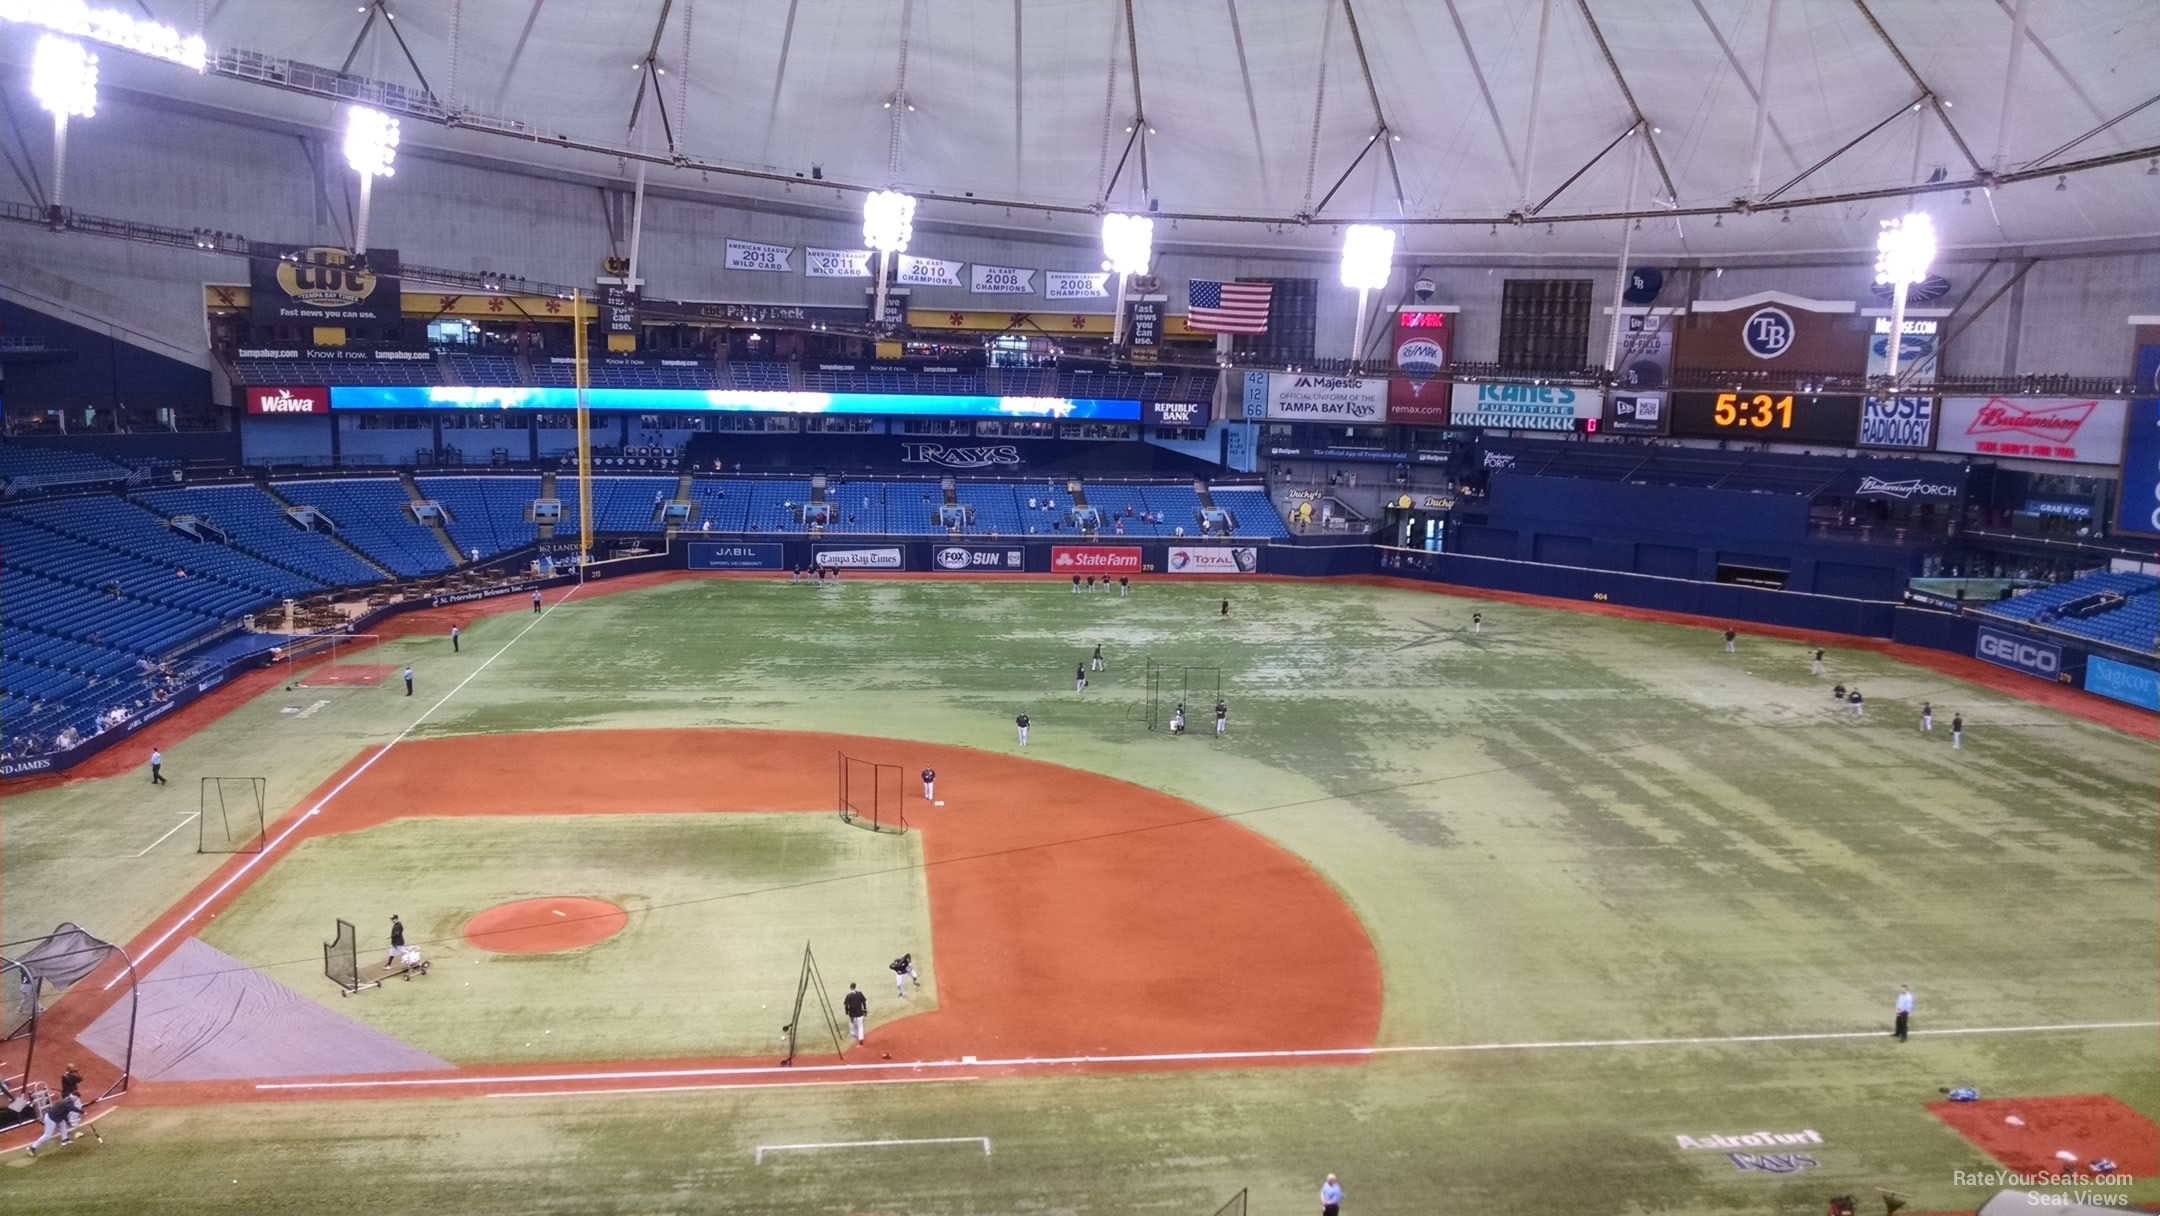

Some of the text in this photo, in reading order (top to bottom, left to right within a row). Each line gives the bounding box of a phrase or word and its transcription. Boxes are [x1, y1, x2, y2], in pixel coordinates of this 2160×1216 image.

[728, 243, 789, 254] AMERICAN LEAGUE
[743, 250, 776, 263] 2013
[733, 260, 783, 270] WILD CARD
[822, 257, 853, 268] 2011
[812, 267, 862, 276] WILD CARD
[912, 265, 946, 277] 2010
[902, 274, 953, 285] CHAMPIONS
[985, 274, 1018, 285] 2008
[1060, 279, 1093, 290] 2008
[975, 284, 1026, 292] CHAMPIONS
[1050, 289, 1101, 297] CHAMPIONS
[301, 292, 324, 300] TAMPA
[280, 308, 377, 319] Fast news you can use.
[612, 322, 632, 331] use.
[1136, 322, 1153, 330] you
[238, 348, 430, 361] tampabay.com Know it now. tampabay.com
[1403, 345, 1438, 359] RE/MAX
[1248, 372, 1264, 385] 42
[1313, 376, 1363, 391] Majestic
[1249, 388, 1262, 400] 12
[1279, 391, 1375, 402] OFFICIAL UNIFORM OF THE
[260, 395, 313, 413] Wawa
[1154, 402, 1198, 413] REPUBLIC
[1279, 402, 1319, 413] TAMPA
[1322, 403, 1344, 414] BAY
[1391, 404, 1442, 415] remax.com
[1481, 404, 1569, 414] FURNITURE
[1163, 411, 1190, 421] BANK
[1247, 404, 1264, 417] 66
[1714, 393, 1794, 429] 5:31
[1862, 418, 1930, 446] RADIOLOGY
[1313, 449, 1324, 457] The
[1324, 449, 1344, 457] Official
[1288, 489, 1322, 500] Ducky's
[1913, 484, 1958, 497] PORCH
[2039, 503, 2062, 513] GRAB
[539, 544, 551, 553] 162
[716, 547, 756, 557] JABIL
[820, 552, 897, 566] Tampa Bay Times
[944, 552, 964, 561] FOX
[972, 552, 1000, 565] SUN
[1193, 555, 1233, 564] TOTAL
[1142, 563, 1155, 572] 370
[449, 591, 483, 604] Petersburg
[1593, 592, 1608, 601] 404
[1979, 634, 2057, 673] GEICO
[14, 758, 51, 773] JAMES
[1675, 1128, 1825, 1150] AstroTurf
